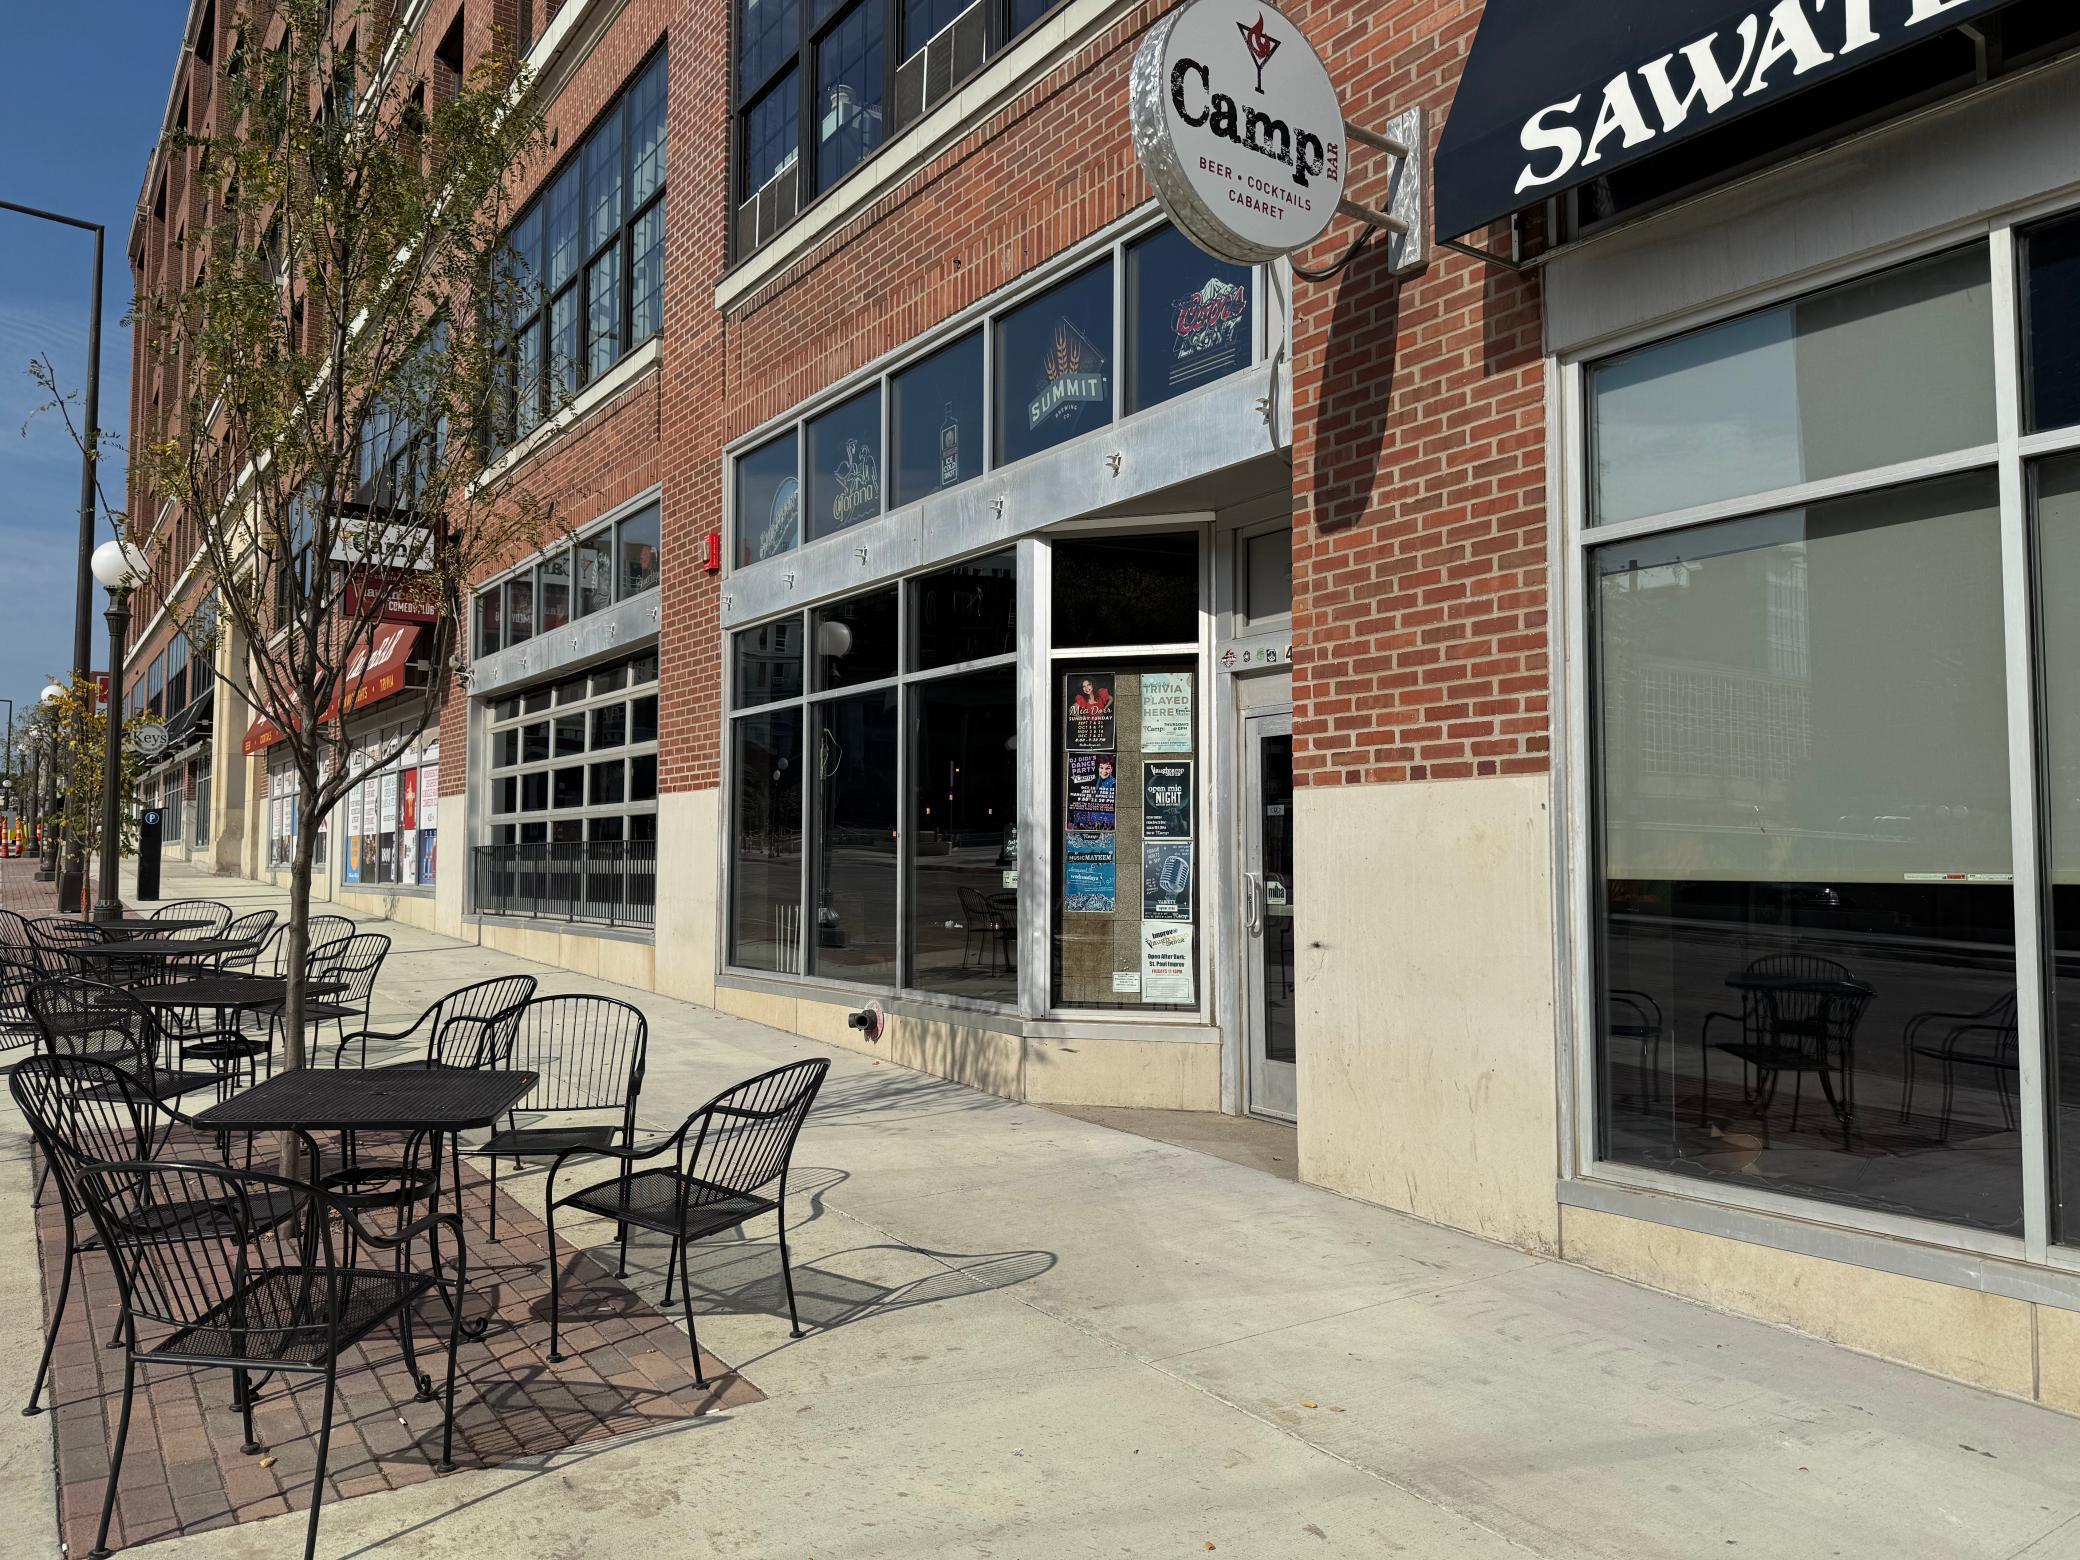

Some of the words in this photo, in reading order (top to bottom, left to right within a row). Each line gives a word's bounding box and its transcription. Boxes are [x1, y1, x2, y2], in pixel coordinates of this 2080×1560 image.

[1514, 0, 1971, 194] SAWAT
[1170, 57, 1324, 188] Camp
[1326, 142, 1338, 183] BAR
[1199, 156, 1232, 180] BEER
[1247, 175, 1312, 212] COCKTAILS
[1228, 189, 1285, 221] CABARET
[1031, 378, 1098, 422] SUMMIT
[833, 485, 873, 521] Corona
[388, 601, 418, 613] COMEDY
[1143, 684, 1183, 694] TRIVIA
[1143, 696, 1189, 706] PLAYED
[1143, 708, 1175, 717] HERE
[133, 730, 167, 747] Keys
[1071, 761, 1096, 769] DANCE
[1072, 766, 1096, 774] PARTY
[1147, 785, 1166, 794] open
[1167, 784, 1182, 792] mic
[1155, 791, 1182, 804] NIGHT
[149, 813, 156, 823] P
